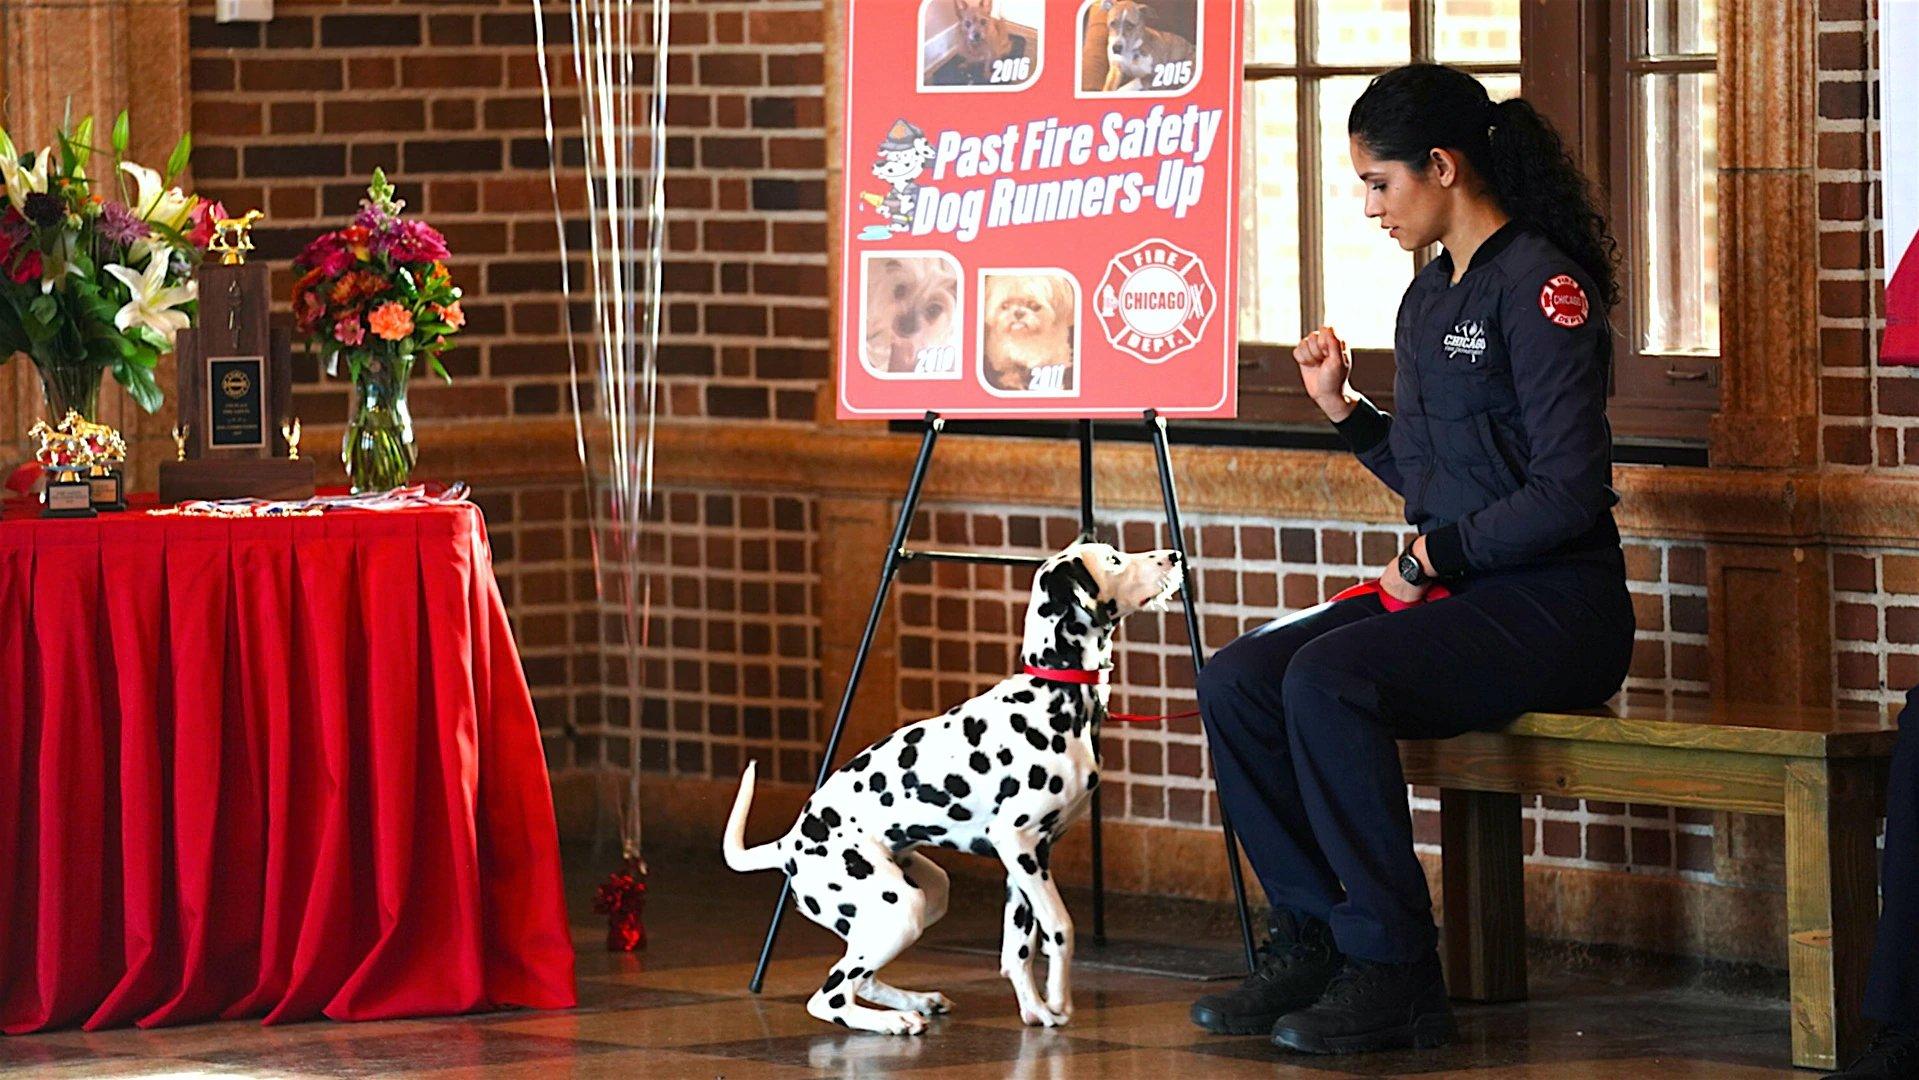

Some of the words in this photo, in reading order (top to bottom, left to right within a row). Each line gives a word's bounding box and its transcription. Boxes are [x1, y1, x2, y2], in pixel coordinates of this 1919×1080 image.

[990, 57, 1030, 84] 2016
[1152, 60, 1193, 87] 2015
[932, 125, 1019, 180] Past
[1020, 117, 1094, 171] Fire
[1098, 104, 1223, 163] Safety
[911, 186, 985, 242] Dog
[987, 158, 1205, 228] Runners-Up
[1133, 248, 1179, 267] FIRE
[1124, 291, 1186, 310] CHICAGO
[1553, 294, 1582, 306] CHICAGO
[1126, 332, 1184, 353] DEPT.
[1443, 334, 1486, 350] CHICAGO
[1028, 363, 1066, 390] 2011
